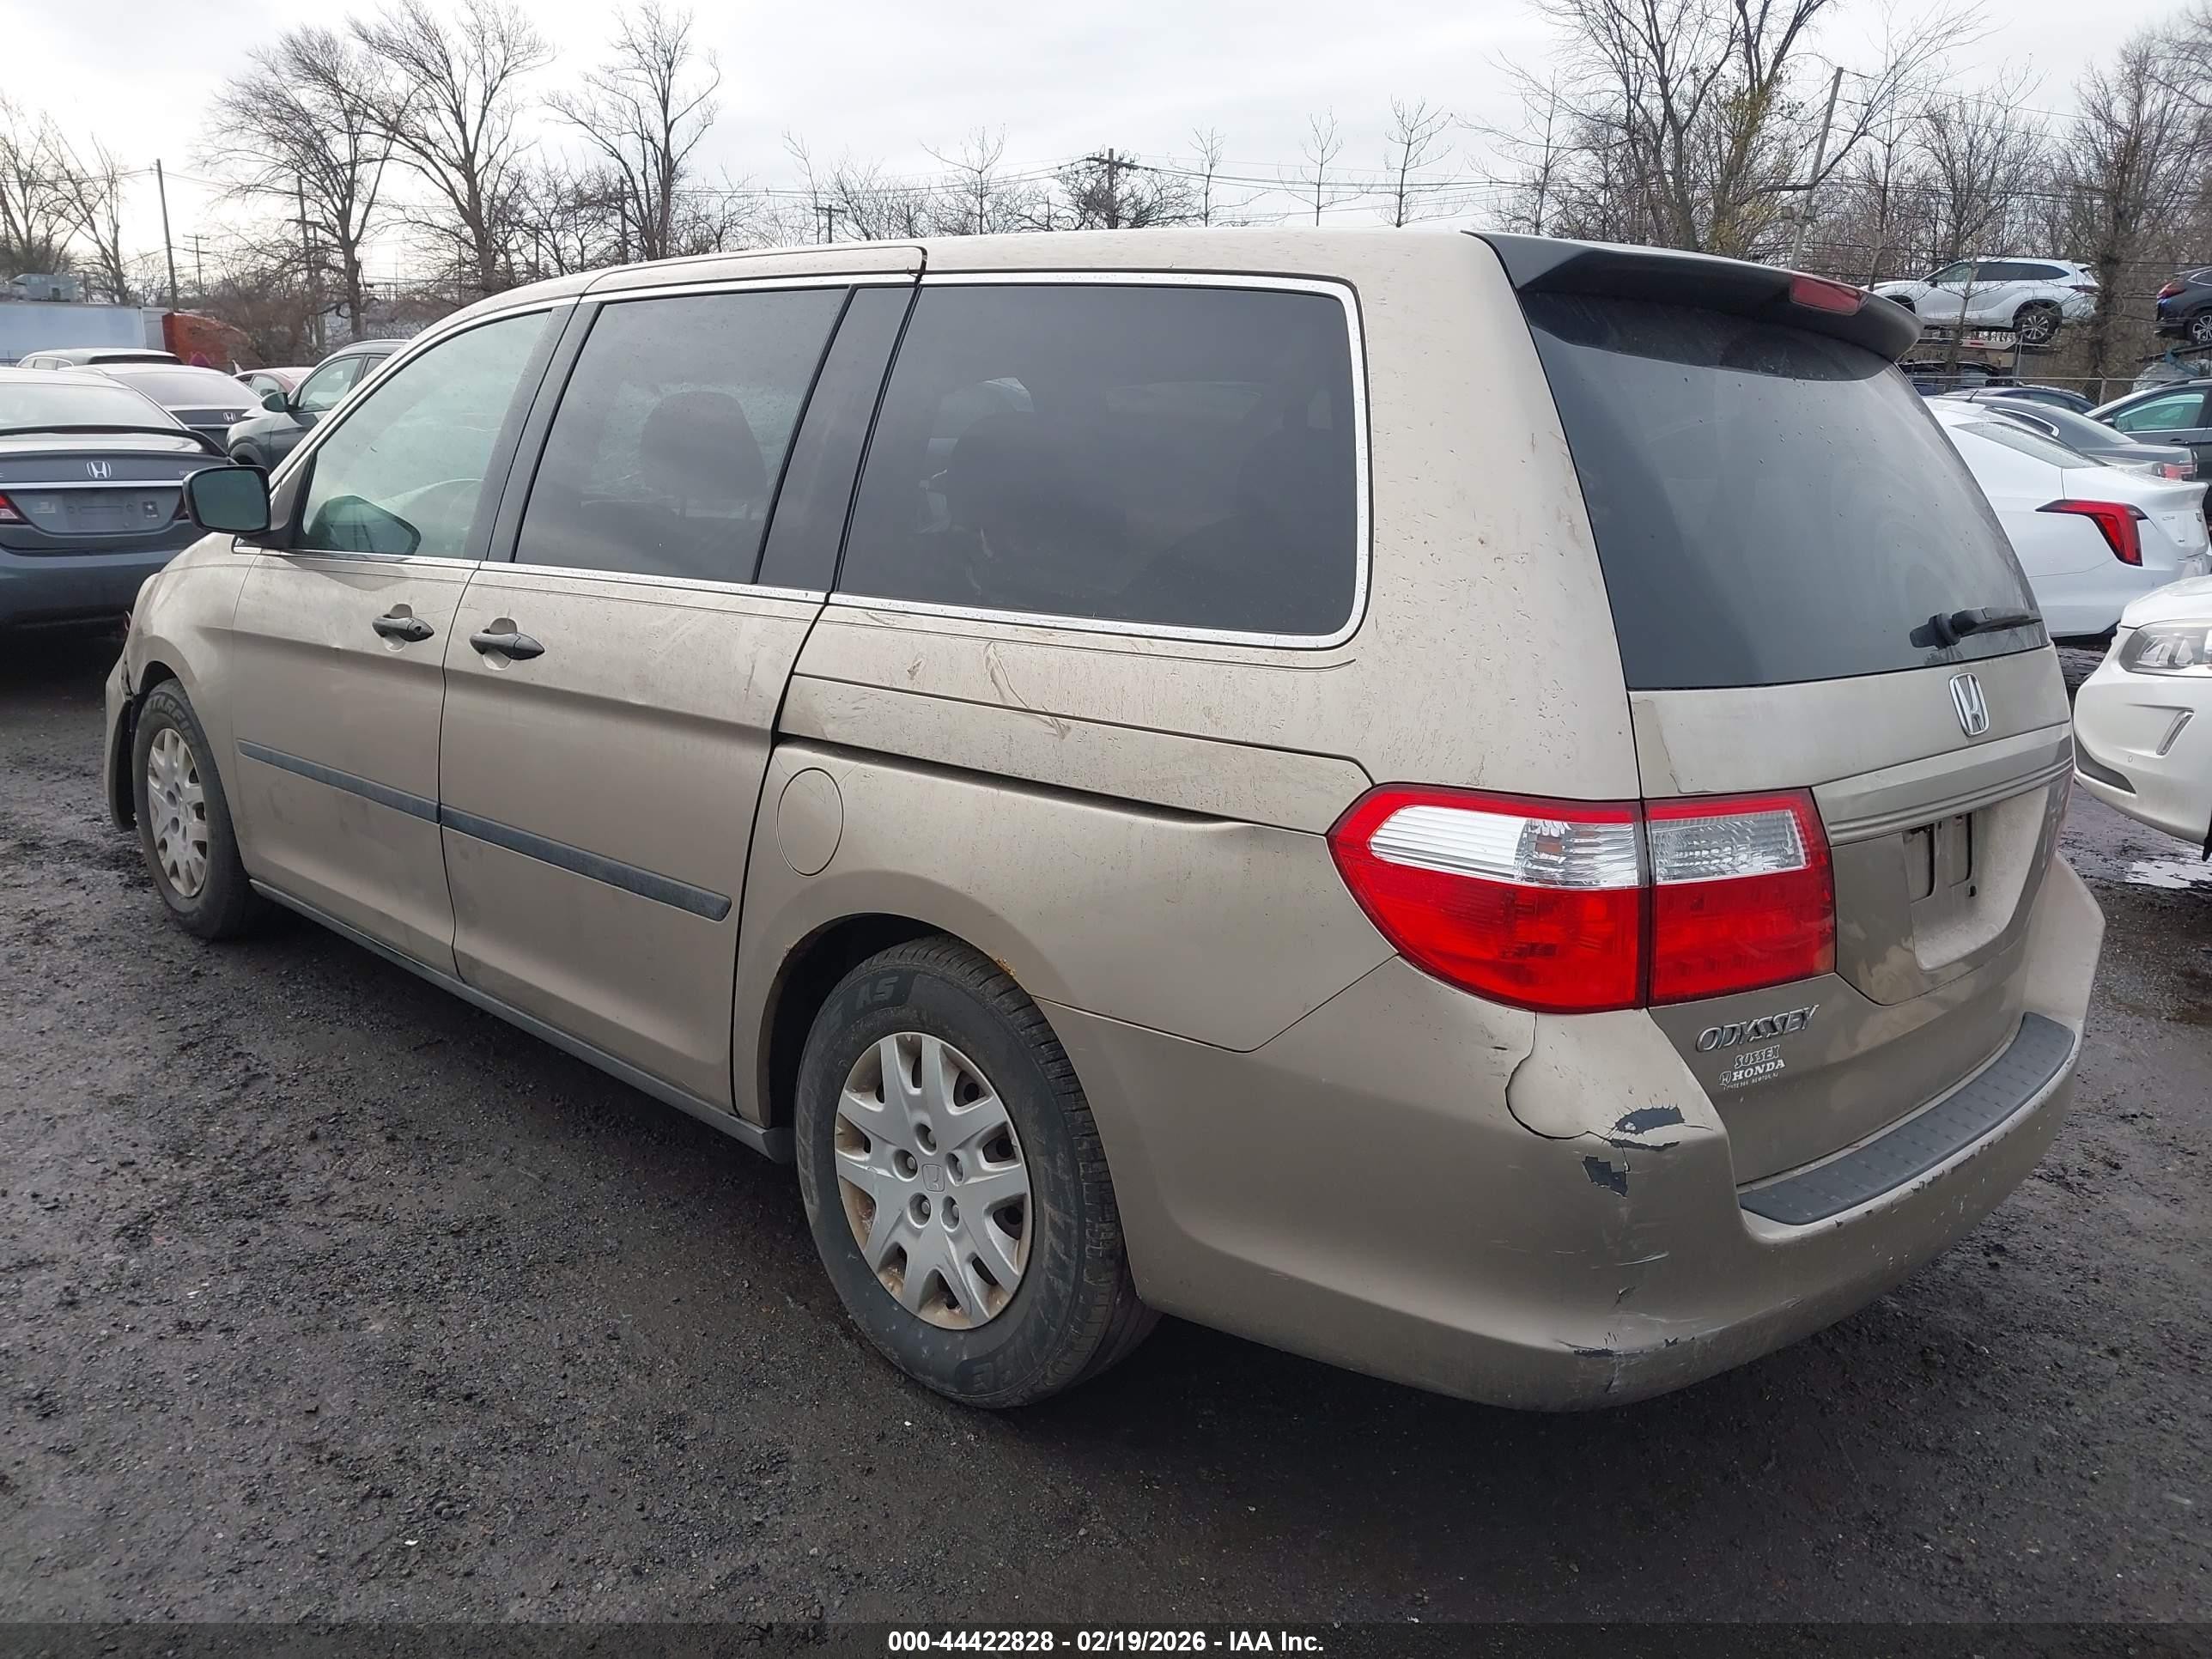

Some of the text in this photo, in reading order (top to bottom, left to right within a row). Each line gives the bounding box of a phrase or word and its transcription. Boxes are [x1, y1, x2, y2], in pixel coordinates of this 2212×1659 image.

[1696, 1004, 1820, 1052] ODYSSEY
[1735, 1044, 1781, 1070] SUSSEX
[1732, 1059, 1786, 1082] HONDA
